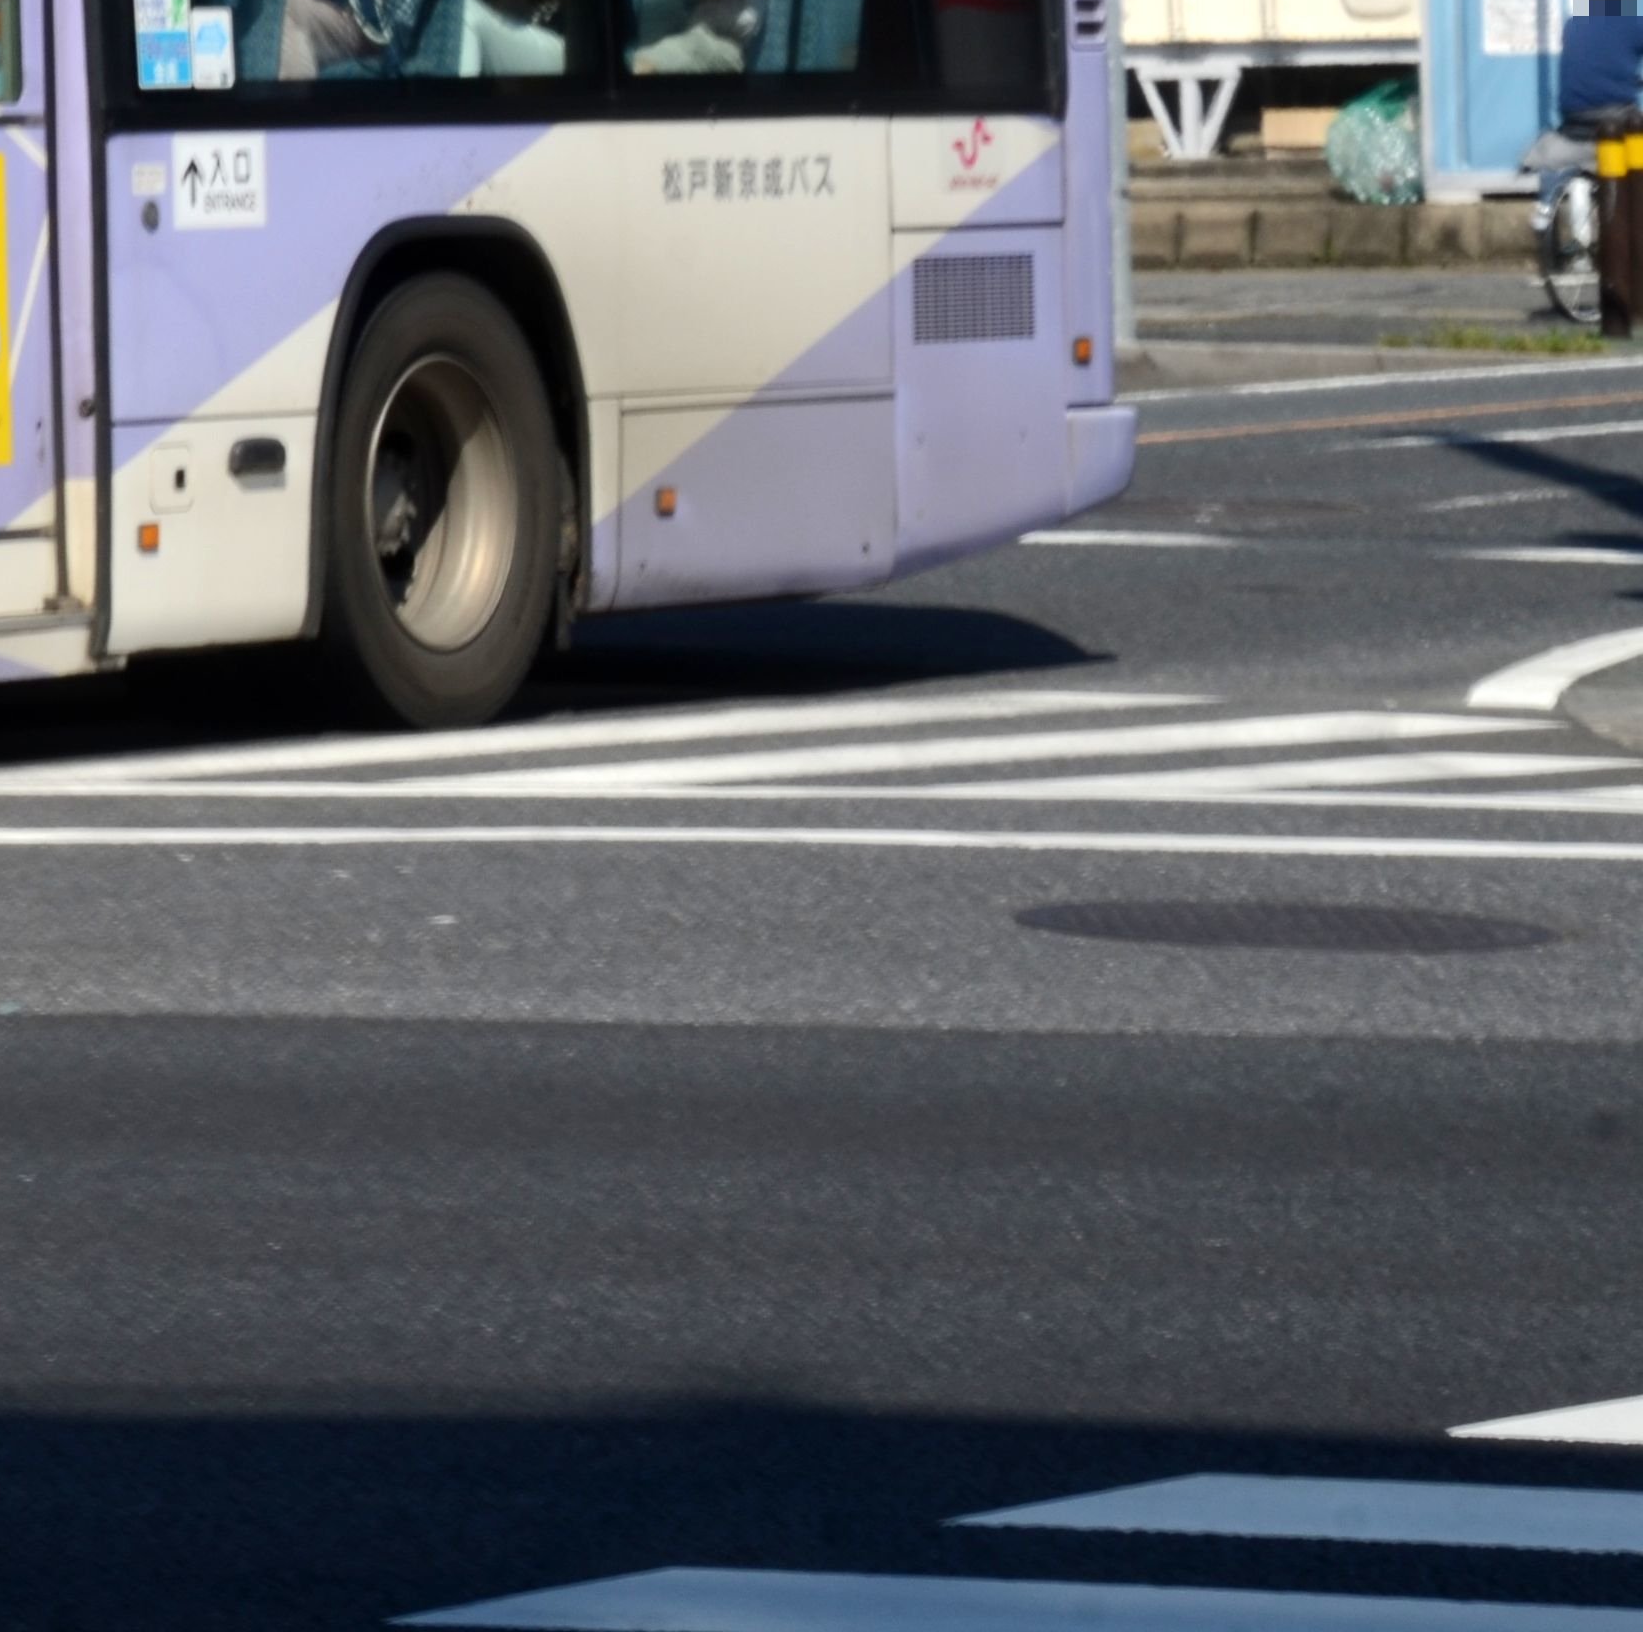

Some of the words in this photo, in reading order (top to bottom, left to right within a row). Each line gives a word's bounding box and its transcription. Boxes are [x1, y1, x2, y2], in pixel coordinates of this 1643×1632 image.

[211, 150, 252, 186] 入口
[662, 152, 835, 204] 松戸新京成バス
